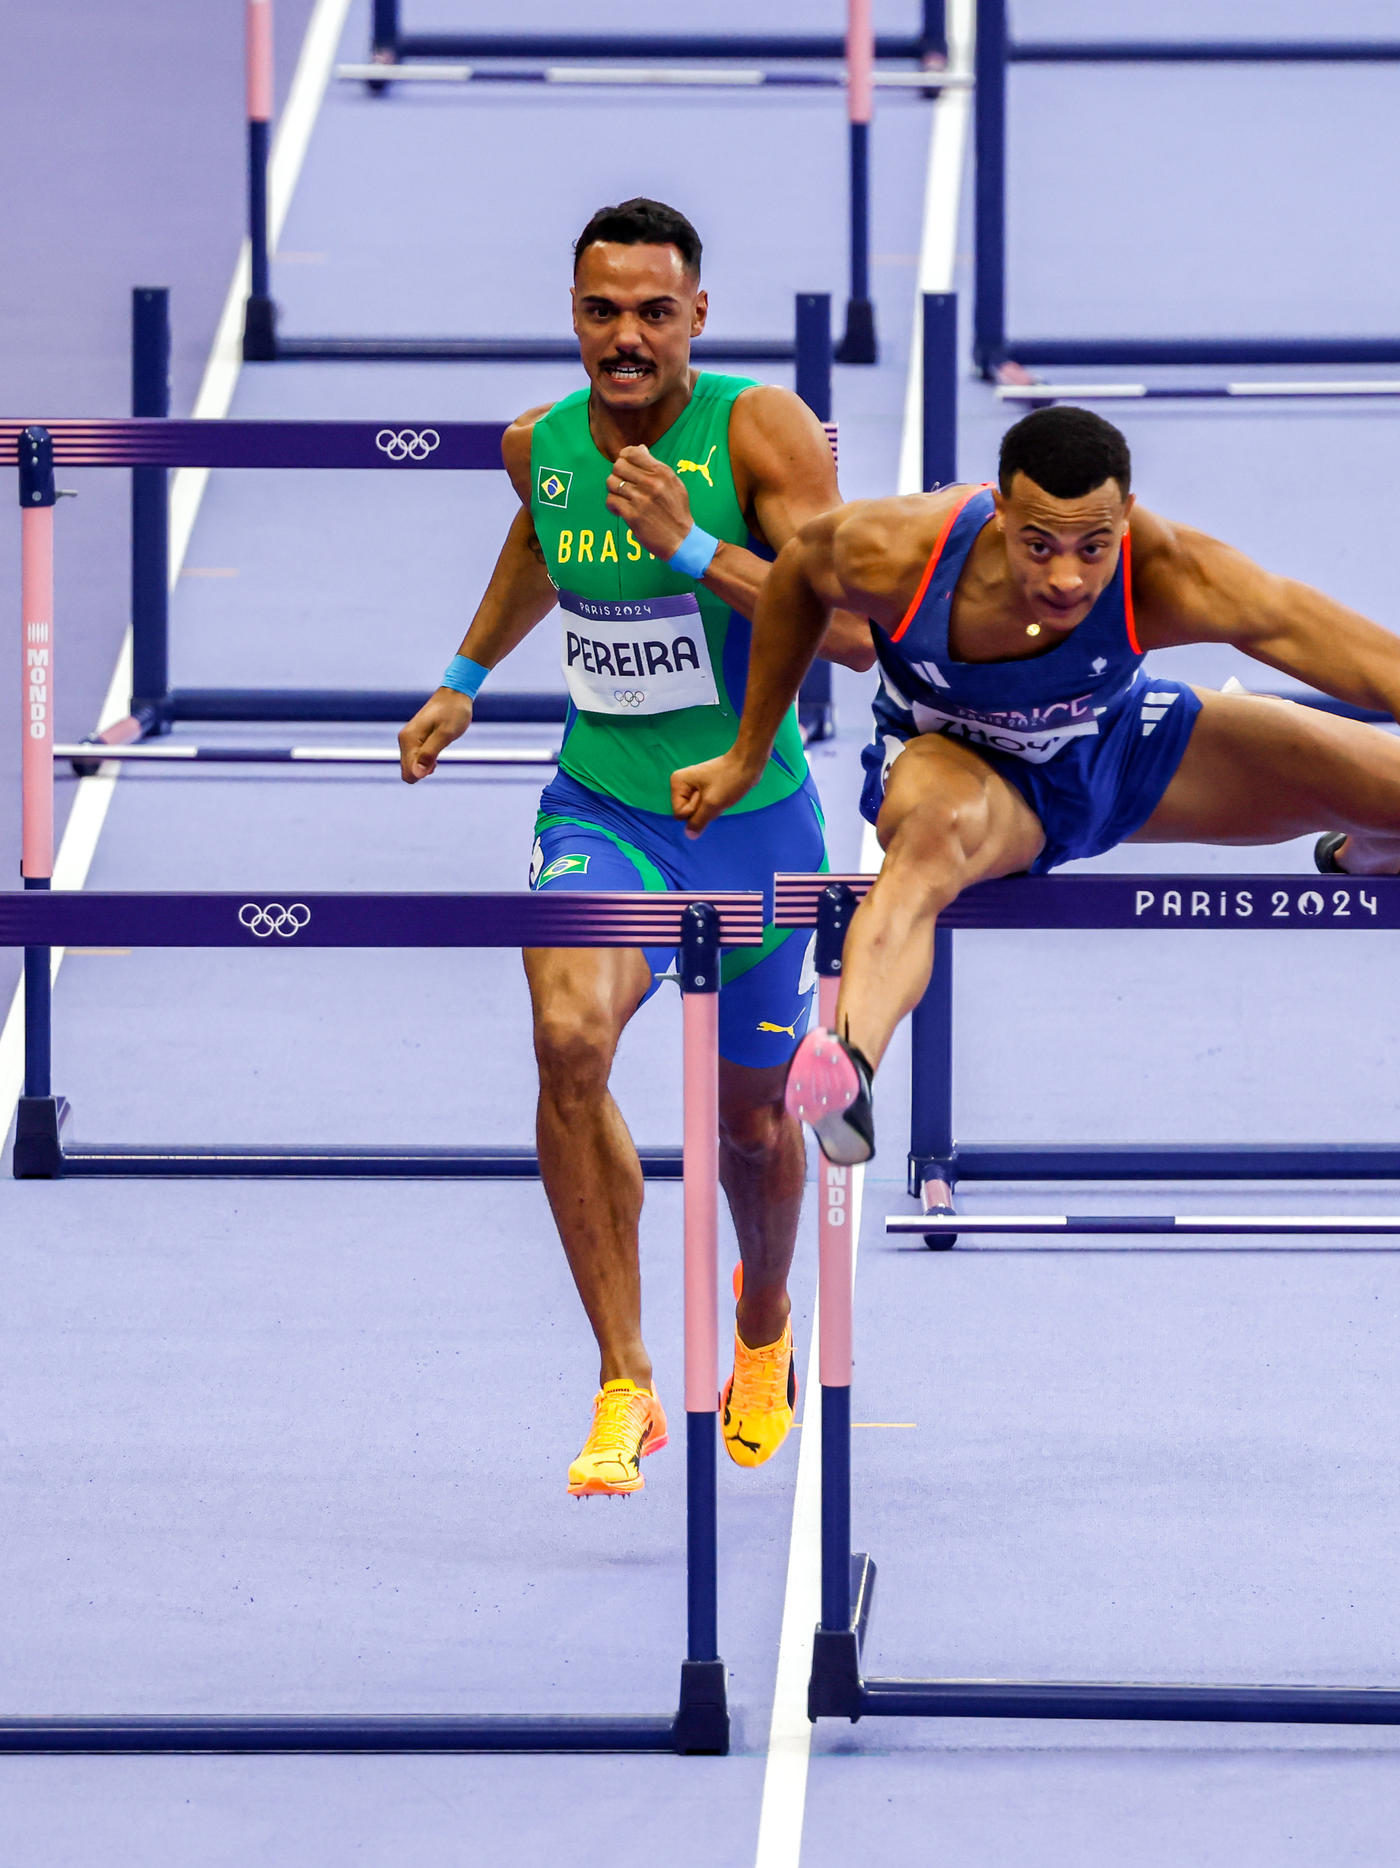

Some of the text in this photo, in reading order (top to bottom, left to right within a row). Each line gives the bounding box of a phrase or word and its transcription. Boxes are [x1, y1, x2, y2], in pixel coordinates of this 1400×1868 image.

[557, 529, 656, 564] BRAS
[614, 605, 652, 616] 2024
[566, 630, 701, 677] PEREIRA
[27, 648, 49, 740] MONDO
[1271, 890, 1378, 917] 2024
